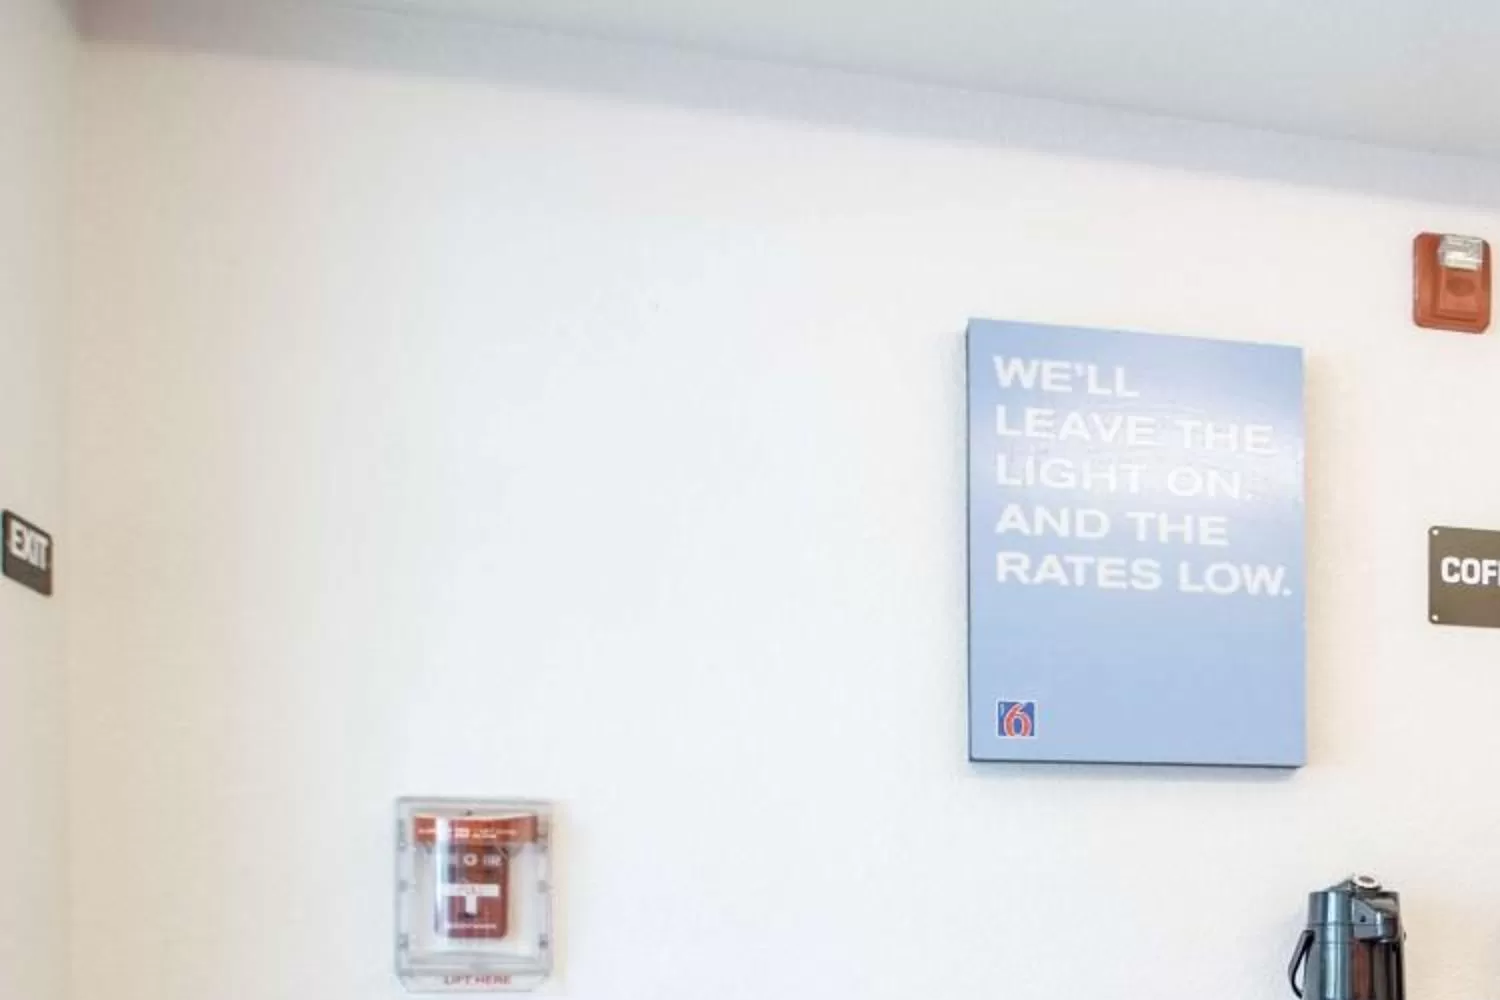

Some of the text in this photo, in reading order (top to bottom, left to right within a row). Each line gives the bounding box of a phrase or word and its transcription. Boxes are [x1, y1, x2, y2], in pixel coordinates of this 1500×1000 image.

[993, 355, 1140, 397] WE'LL
[996, 404, 1276, 453] LEAVE THE
[996, 453, 1252, 499] LIGHT ON.
[995, 503, 1230, 546] AND THE
[996, 551, 1292, 597] RATES LOW.
